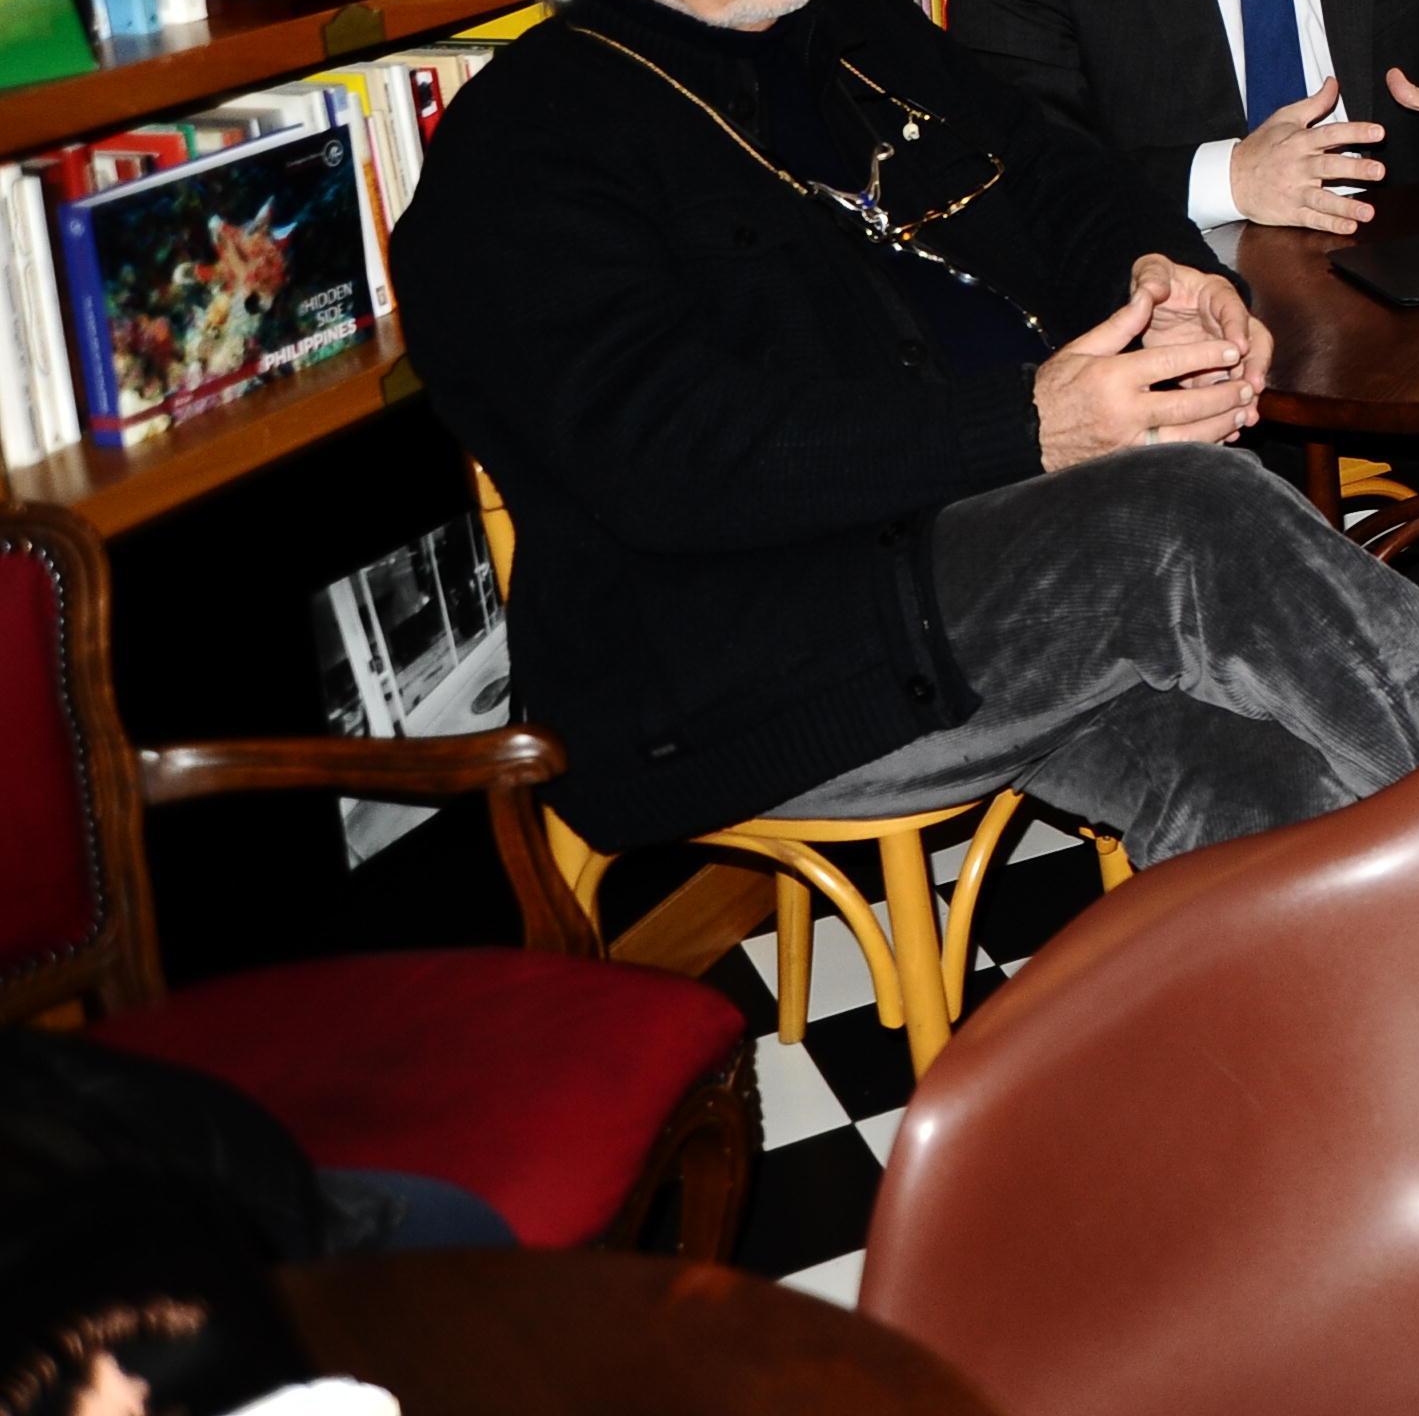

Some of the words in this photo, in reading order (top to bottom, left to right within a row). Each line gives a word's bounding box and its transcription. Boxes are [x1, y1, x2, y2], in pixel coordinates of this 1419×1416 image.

[305, 283, 353, 315] HIDDEN
[316, 302, 346, 328] SIDE
[262, 319, 358, 371] PHILIPPINES
